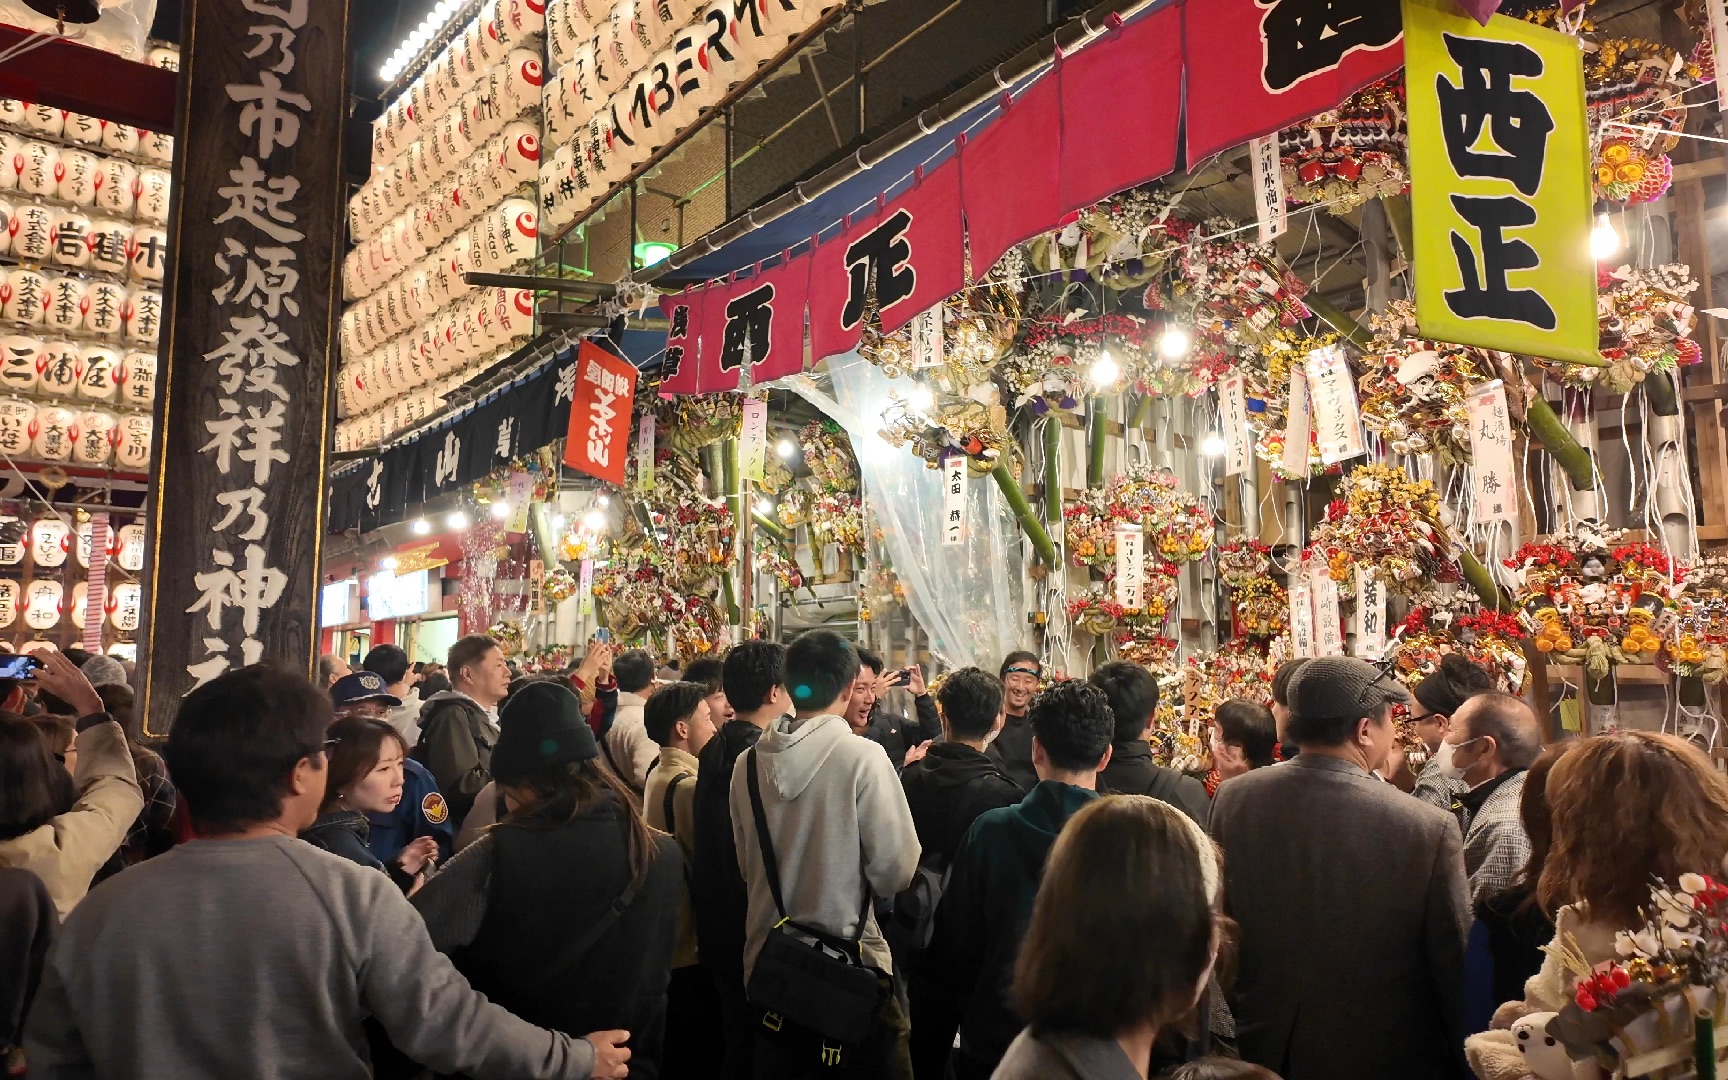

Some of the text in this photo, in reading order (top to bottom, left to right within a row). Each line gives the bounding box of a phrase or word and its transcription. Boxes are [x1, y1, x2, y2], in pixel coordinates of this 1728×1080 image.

[1436, 31, 1557, 331] 西正
[472, 225, 482, 268] ISAGO
[487, 215, 499, 260] ISAGO
